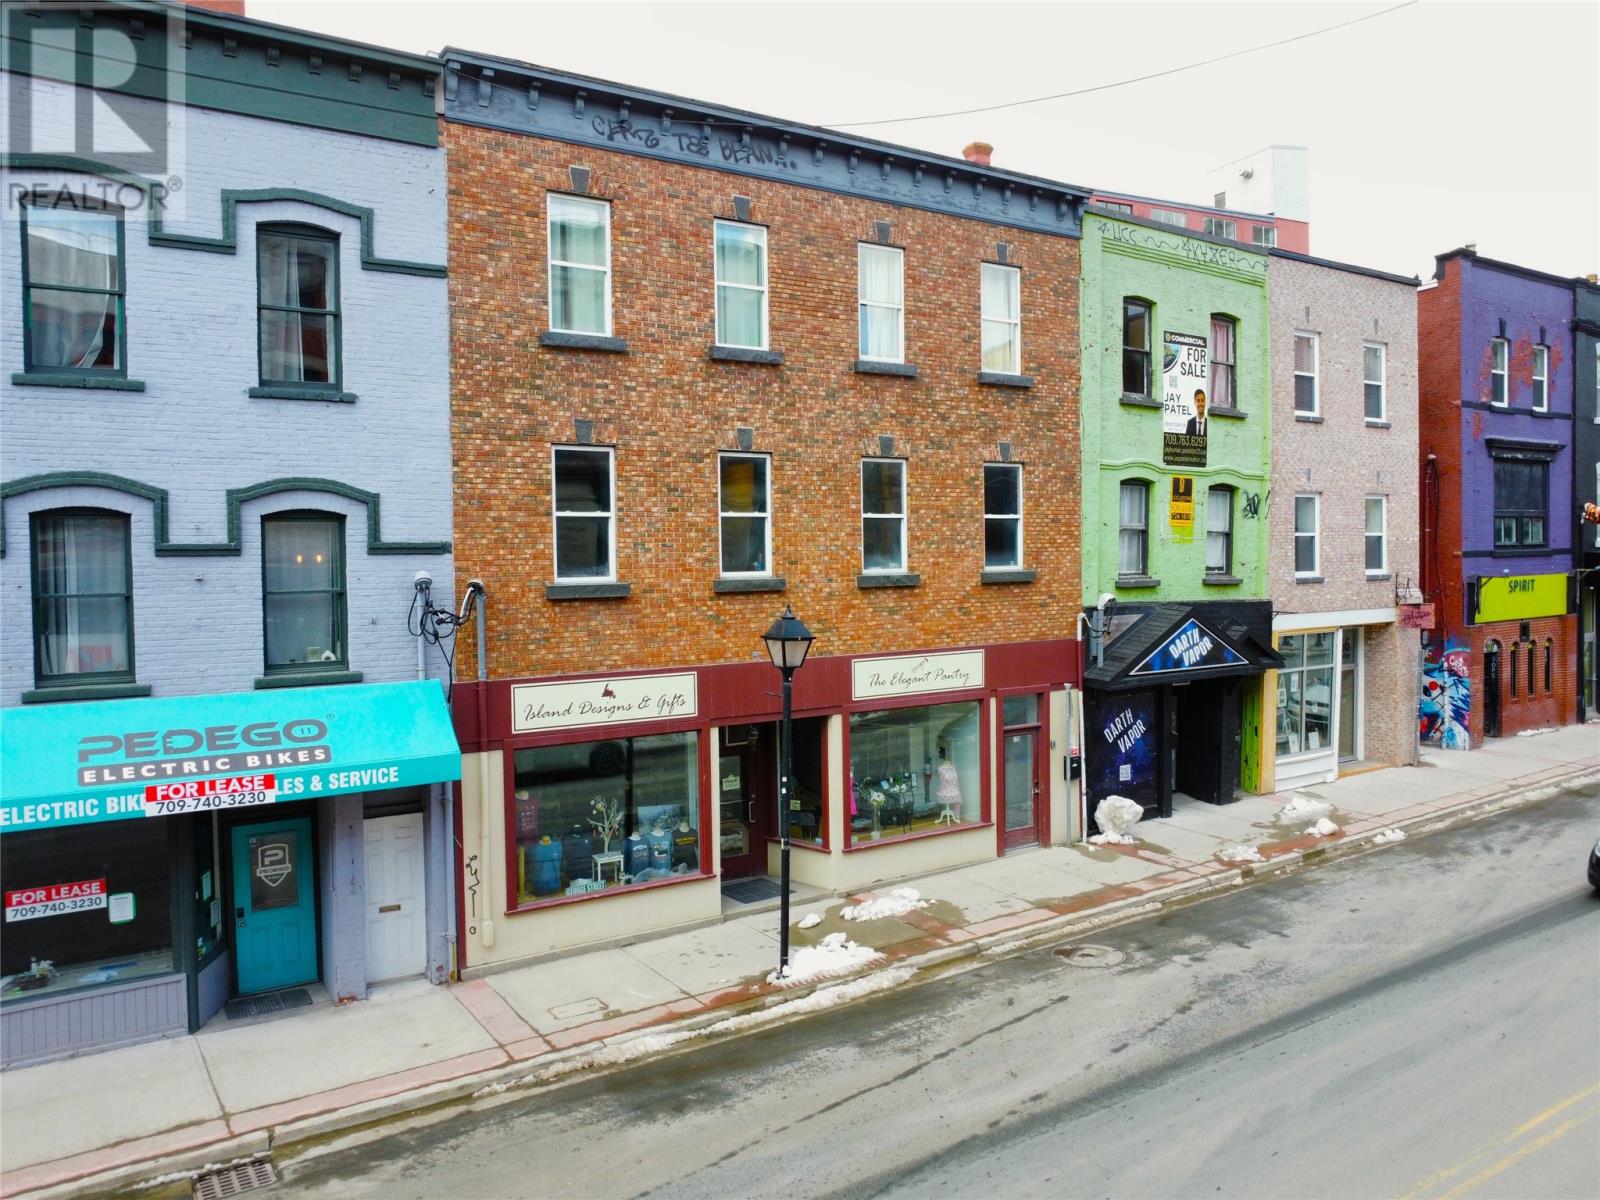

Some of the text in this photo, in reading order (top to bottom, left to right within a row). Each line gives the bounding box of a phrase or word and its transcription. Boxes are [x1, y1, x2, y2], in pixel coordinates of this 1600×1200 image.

[1187, 347, 1207, 363] FOR
[1180, 361, 1207, 378] SALE
[1164, 392, 1182, 404] JAY
[1164, 403, 1192, 416] PATEL
[1165, 433, 1207, 447] 709.763.6297
[1508, 579, 1536, 593] SPIRIT
[1169, 628, 1201, 659] DARTH
[1182, 636, 1214, 667] VAPOR
[868, 668, 970, 689] The Elegant Pantry
[523, 702, 574, 721] Island
[579, 700, 633, 719] Designs
[656, 693, 687, 715] Gifts
[1104, 708, 1134, 743] DARTH
[1117, 719, 1147, 753] VAPOR
[83, 748, 326, 783] ELECTRIC BIKES
[0, 798, 99, 827] ELECTRIC
[310, 775, 323, 792] &
[328, 766, 399, 790] SERVICE
[156, 775, 265, 801] FOR LEASE
[156, 791, 267, 815] 709-740-3230
[11, 882, 101, 906] FOR LEASE
[12, 896, 102, 919] 709-740-3230
